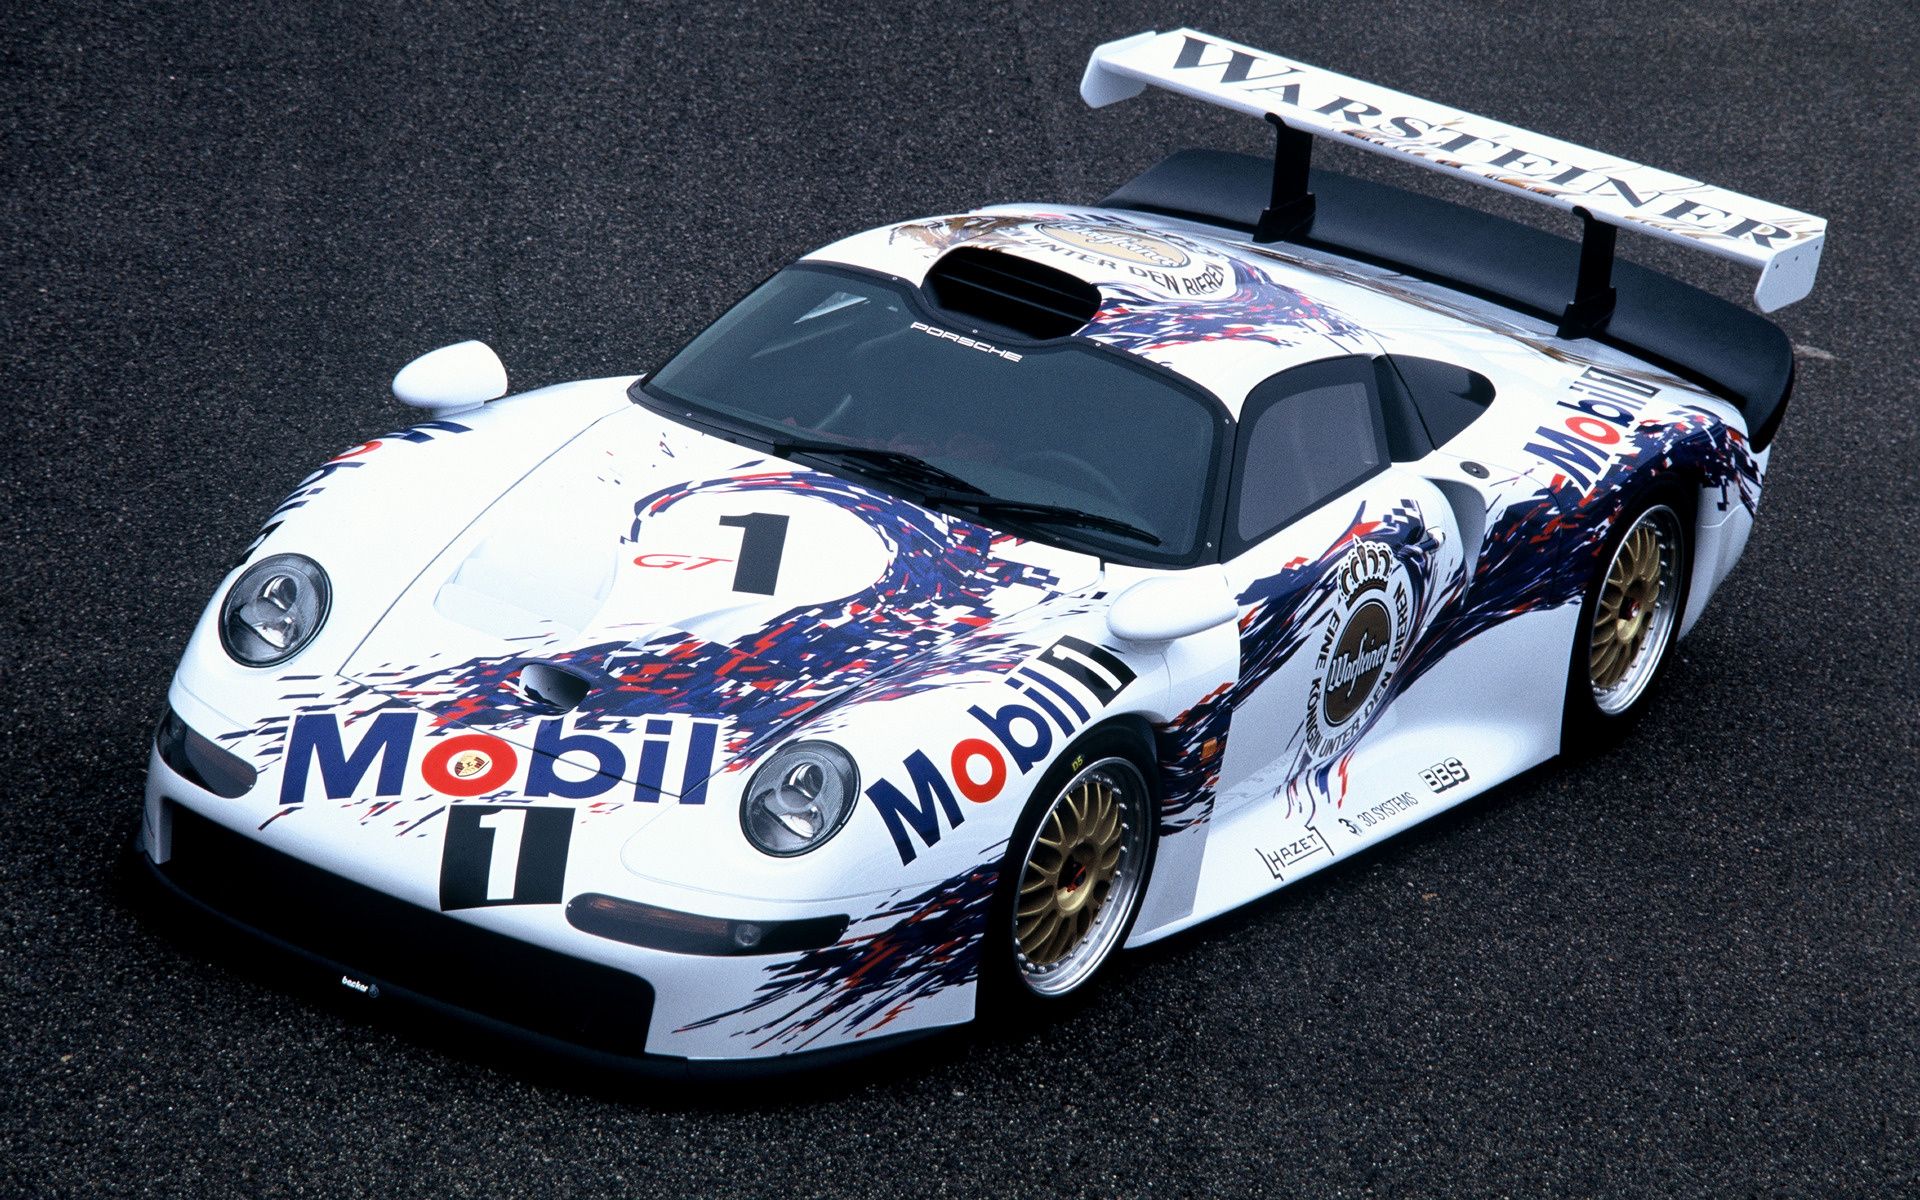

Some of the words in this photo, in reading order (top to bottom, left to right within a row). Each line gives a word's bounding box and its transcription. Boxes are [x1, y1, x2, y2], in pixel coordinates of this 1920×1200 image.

[1173, 35, 1793, 247] WARSTEINER
[1024, 238, 1117, 271] UNTER
[1129, 265, 1180, 295] DEN
[1186, 261, 1225, 297] BIEREN
[910, 321, 1023, 362] PORSCHE
[1523, 381, 1647, 491] Mobil
[633, 553, 734, 571] GT
[719, 512, 790, 596] 1
[1315, 609, 1341, 670] EINE
[1390, 580, 1408, 662] BIEREN
[1364, 671, 1393, 719] DEN
[279, 712, 719, 805] Mobil
[1319, 717, 1360, 758] UNTER
[864, 666, 1091, 867] Mobil
[1418, 757, 1471, 794] BBS
[1371, 791, 1419, 821] SYSTEMS
[1267, 834, 1319, 871] HAZET
[341, 975, 369, 993] becker
